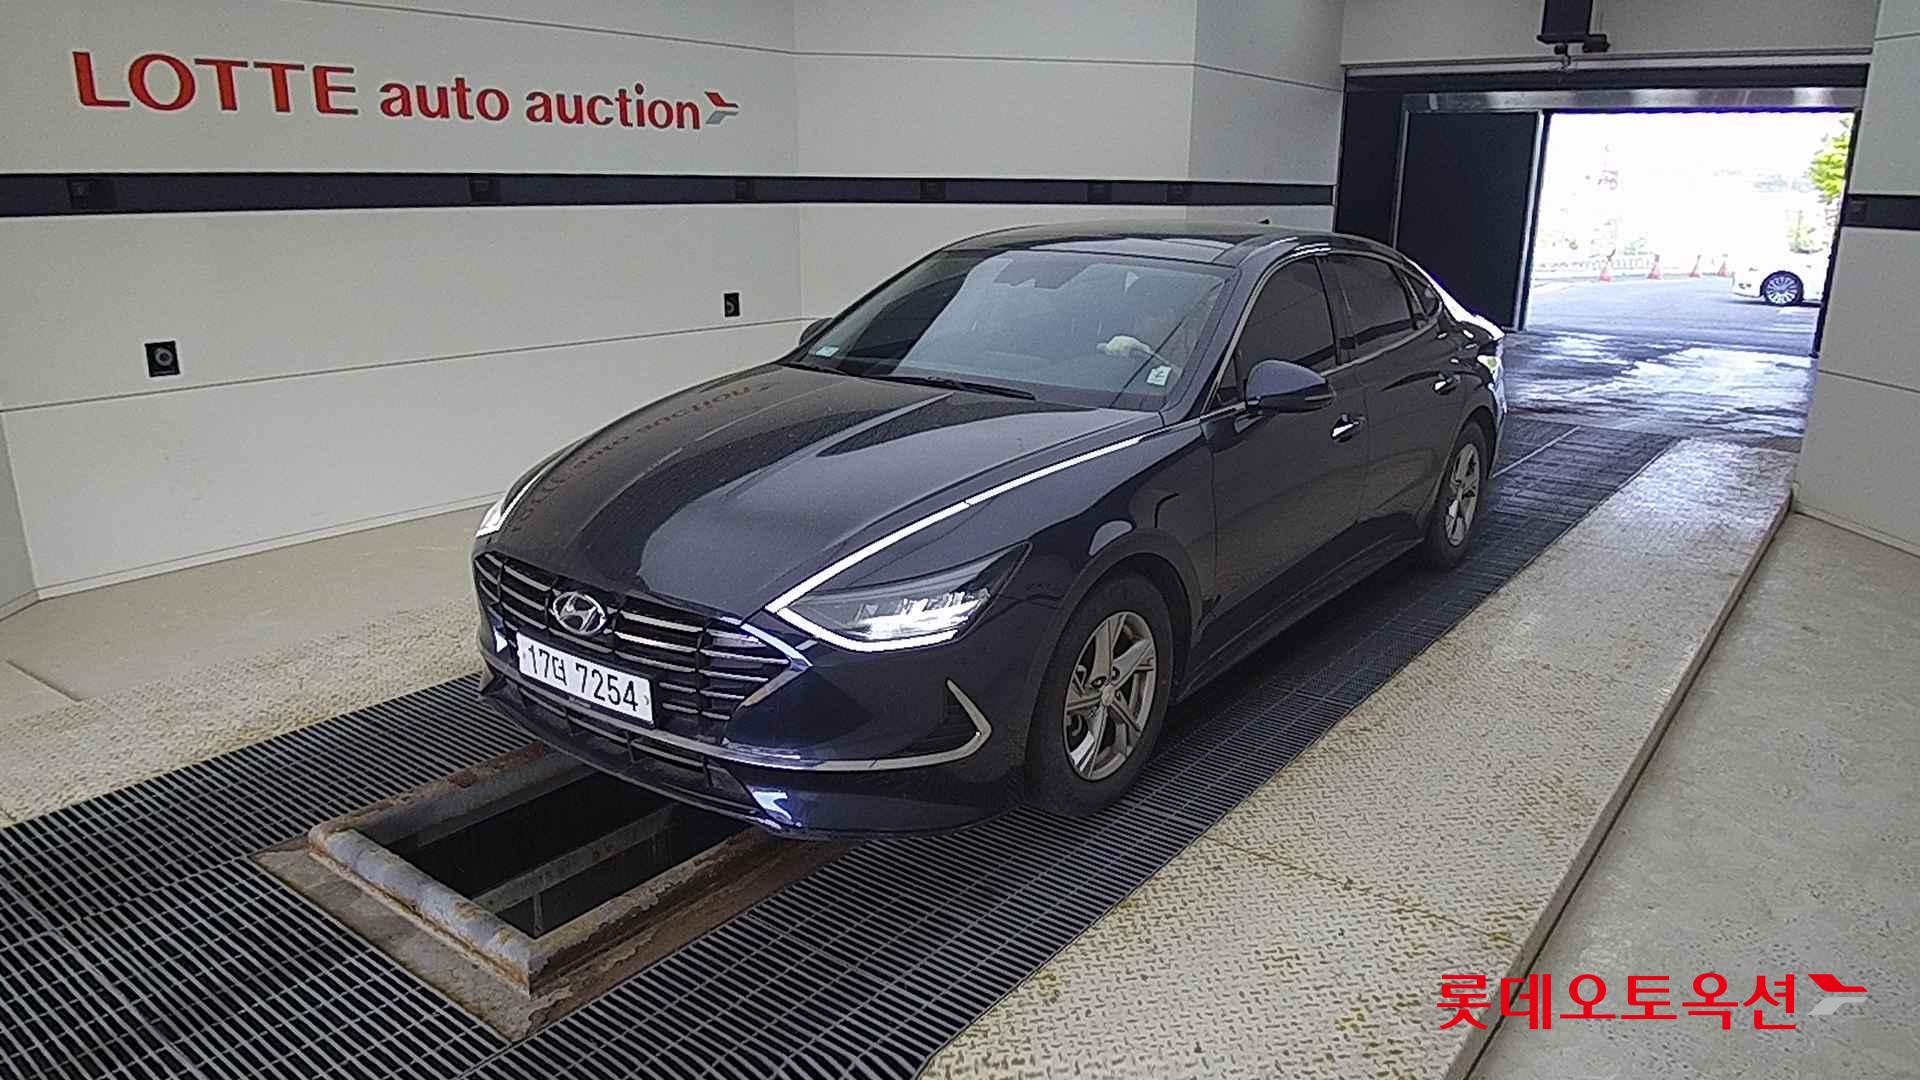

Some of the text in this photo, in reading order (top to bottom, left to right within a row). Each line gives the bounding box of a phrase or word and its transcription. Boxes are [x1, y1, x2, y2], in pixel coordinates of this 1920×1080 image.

[72, 51, 701, 130] LOTTE auto auction
[528, 644, 639, 712] 17더 7254
